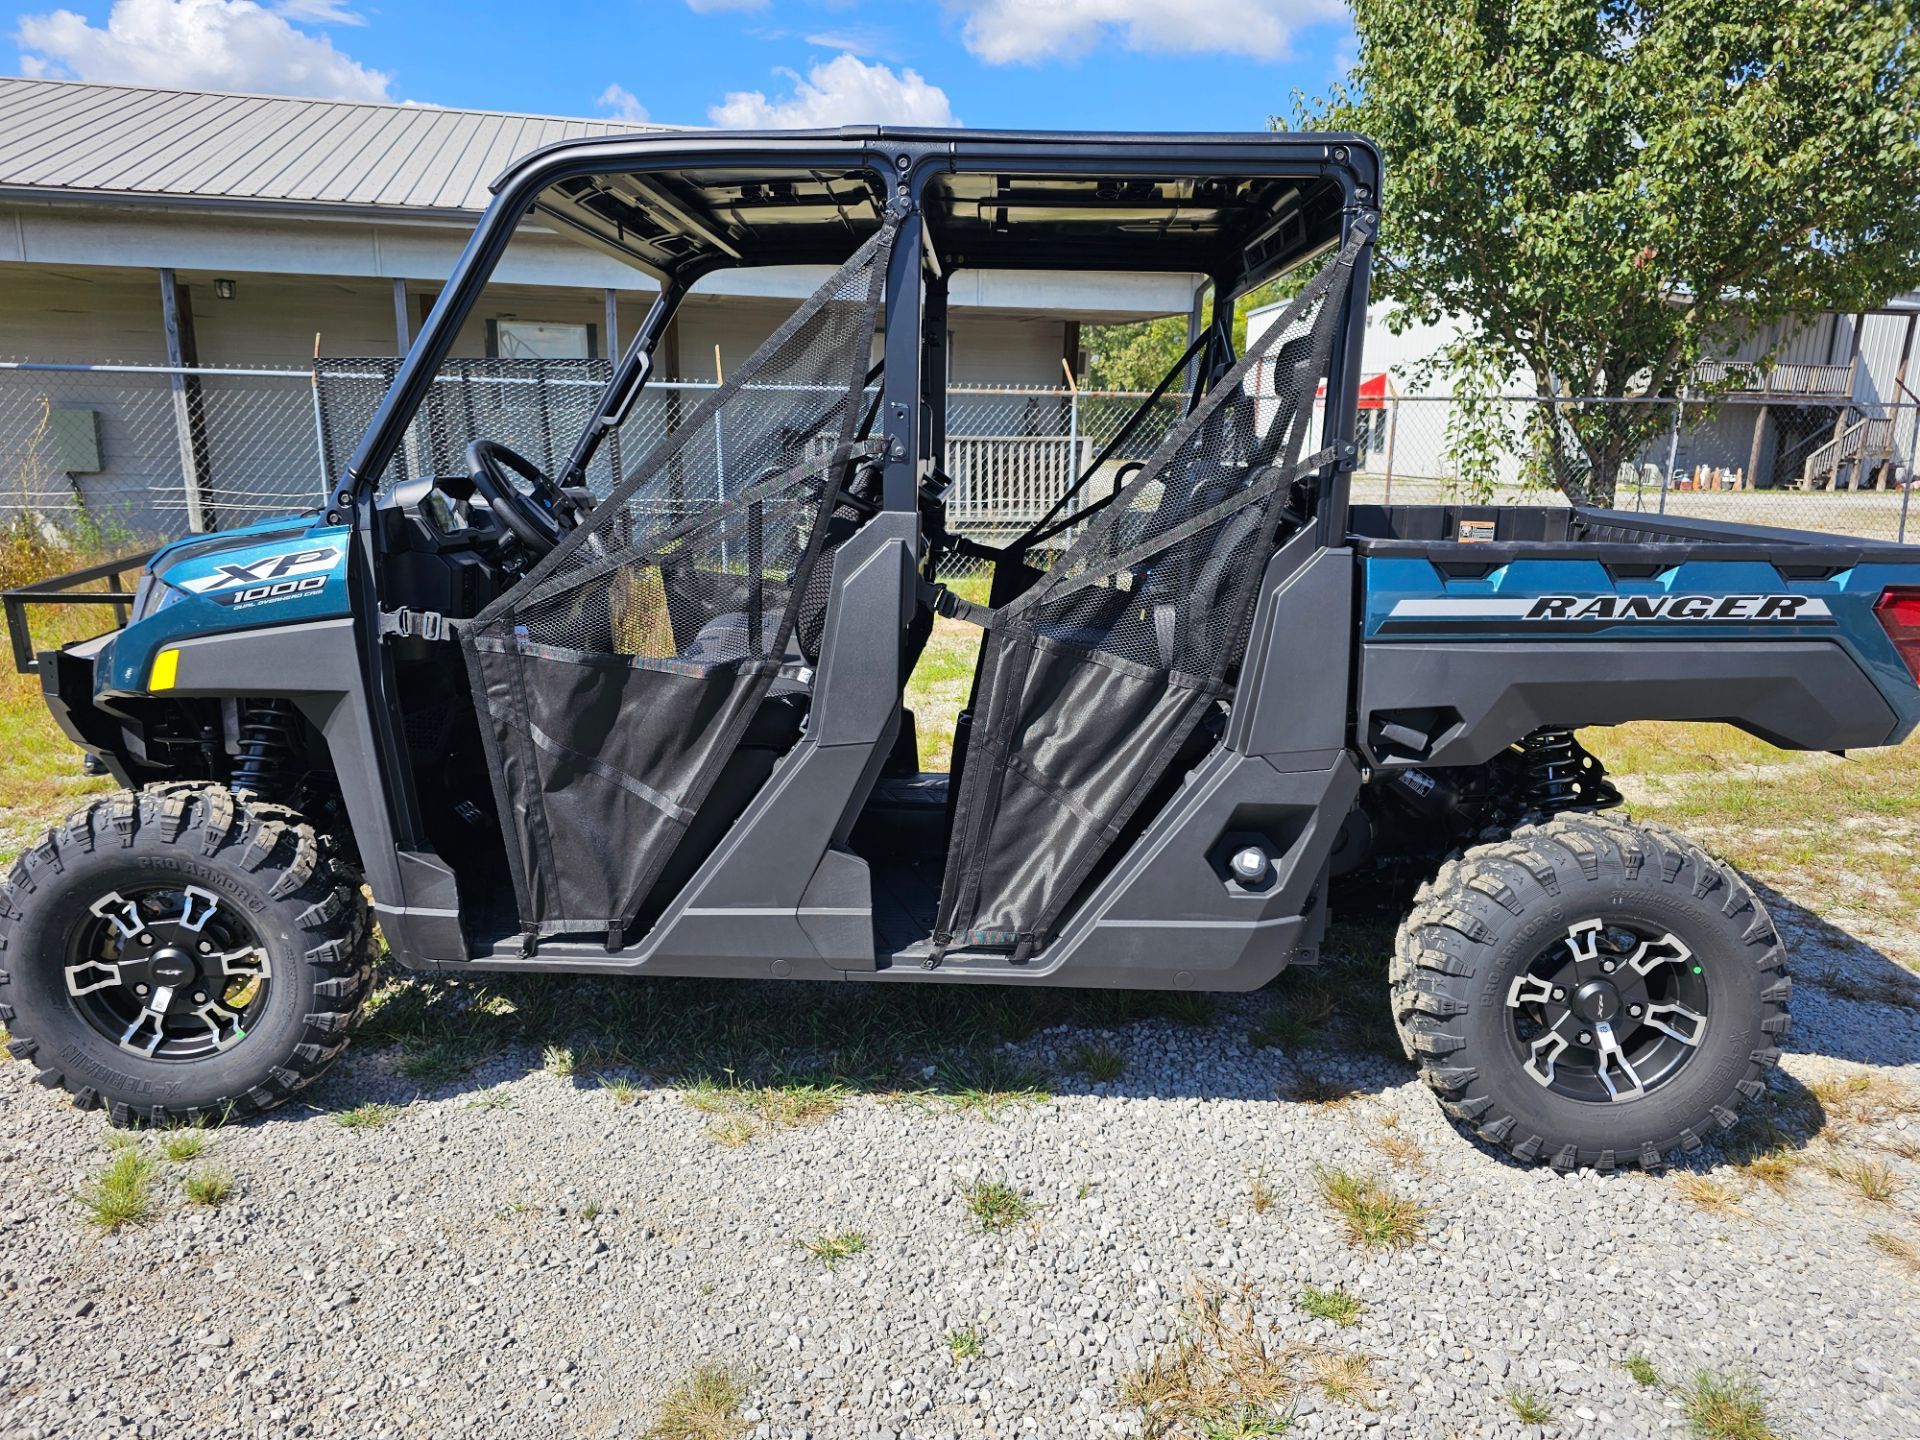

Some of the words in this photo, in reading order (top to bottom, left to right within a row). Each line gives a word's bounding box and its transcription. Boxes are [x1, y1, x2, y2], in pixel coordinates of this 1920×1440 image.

[203, 548, 338, 590] XP
[233, 576, 328, 603] 1000
[233, 602, 256, 610] DUAL
[258, 593, 303, 606] OVERHEAD
[304, 589, 323, 597] CAM
[1522, 596, 1808, 620] RANGER
[138, 856, 180, 870] PRO
[184, 862, 249, 900] ARMOR
[1481, 972, 1500, 1007] PRO
[1496, 915, 1549, 969] ARMOR
[60, 1043, 182, 1097] X-TERRAIN
